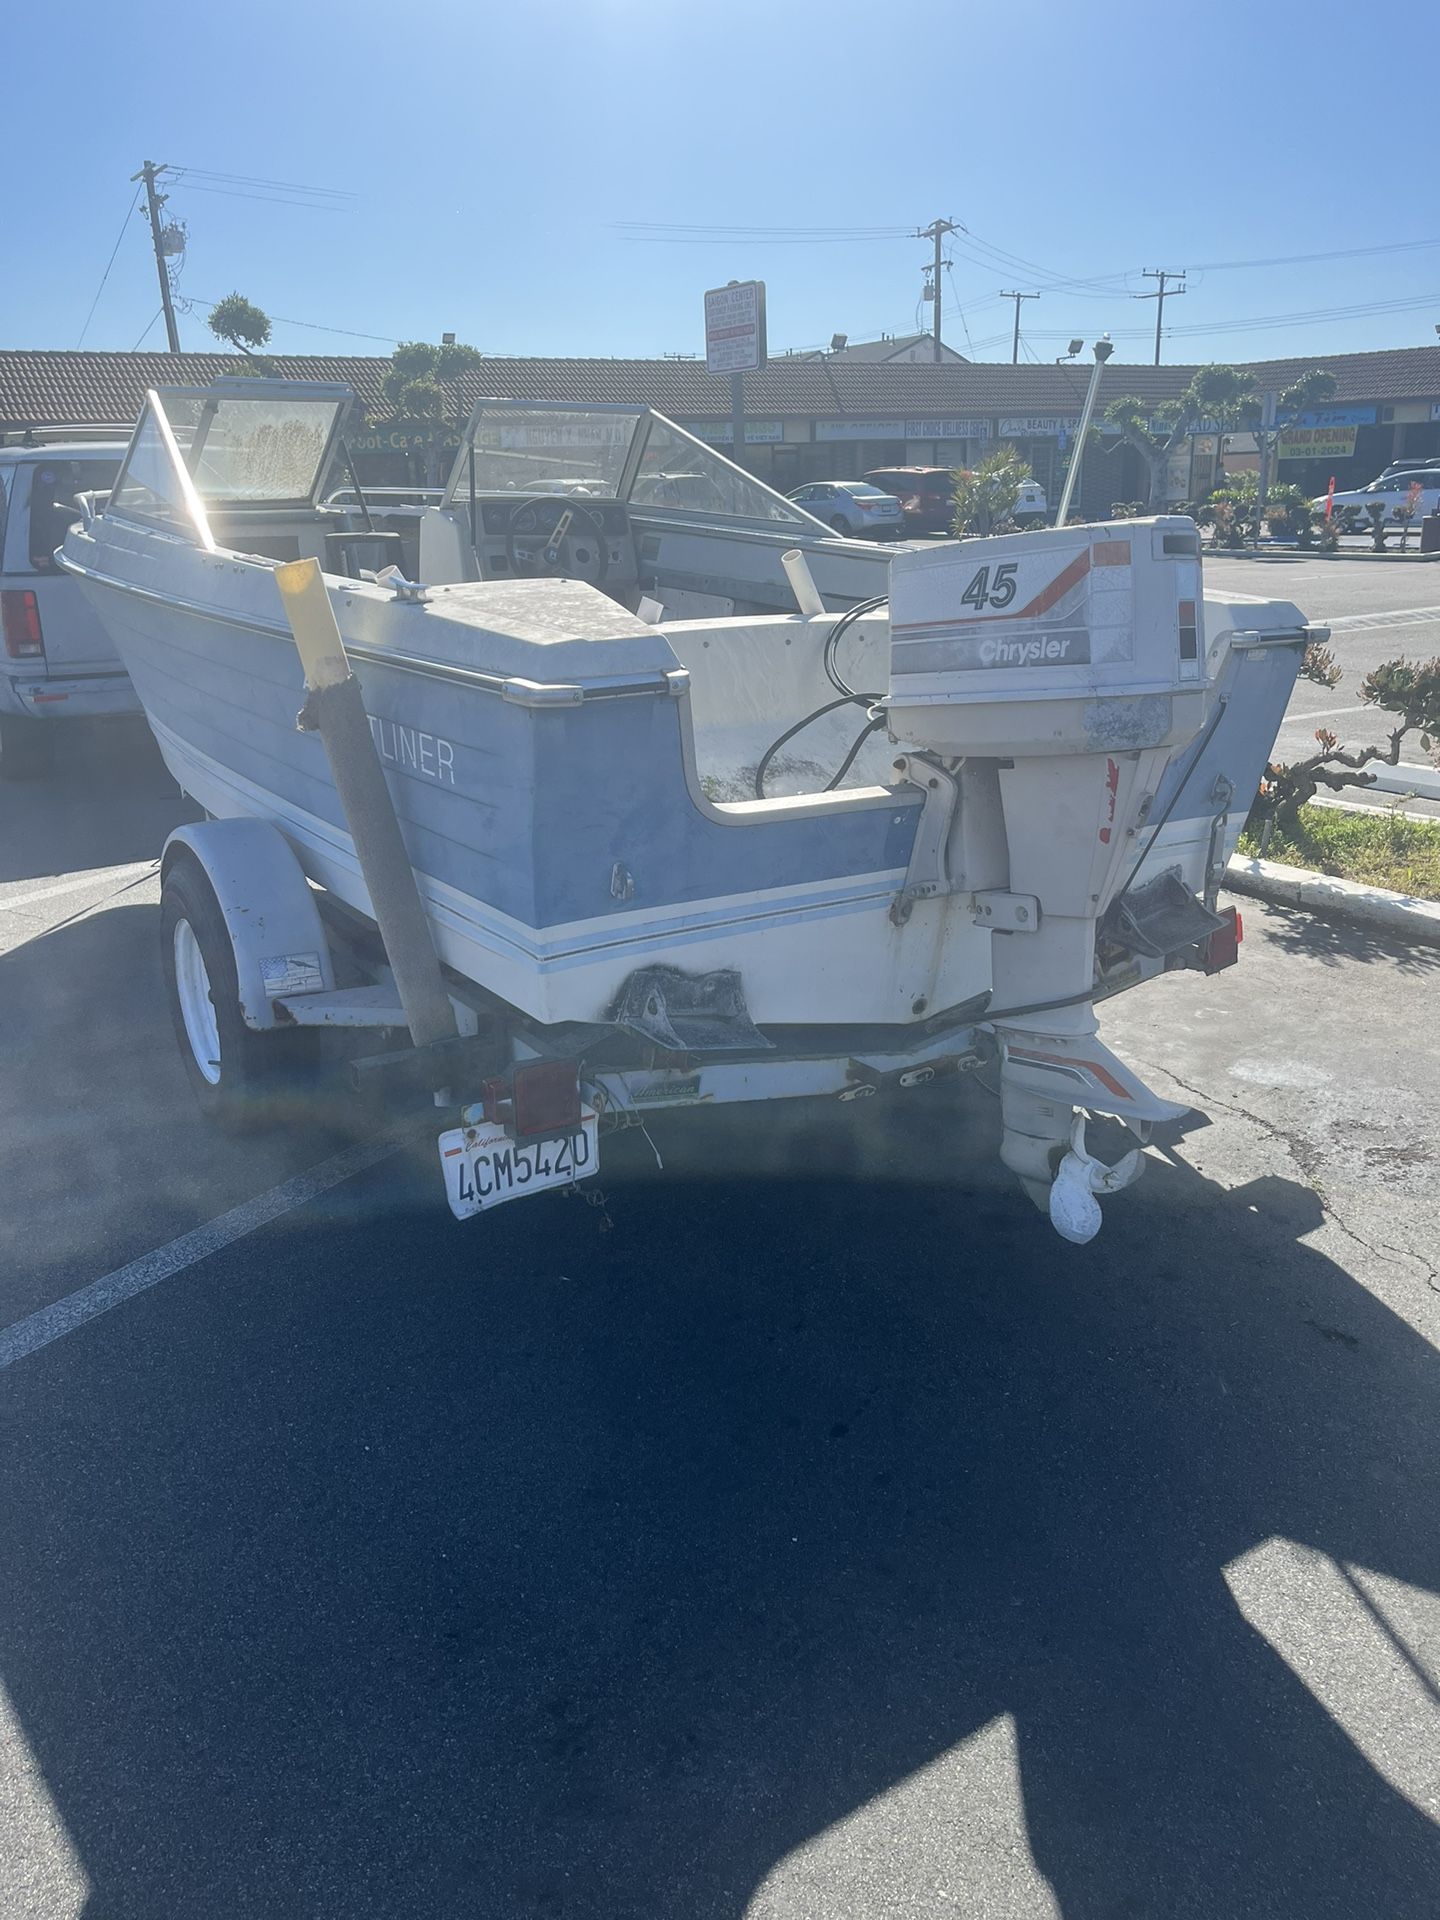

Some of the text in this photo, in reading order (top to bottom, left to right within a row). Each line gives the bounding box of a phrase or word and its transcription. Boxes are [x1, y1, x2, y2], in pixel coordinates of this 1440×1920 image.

[731, 287, 754, 302] CENTER
[1027, 419, 1057, 431] BEAUTY
[1282, 425, 1355, 444] GRAND OPENING
[1289, 446, 1346, 457] 03-01-2024
[960, 562, 1018, 611] 45
[978, 636, 1071, 665] Chrysler
[634, 1085, 695, 1097] American
[459, 1129, 589, 1202] 4CM5420
